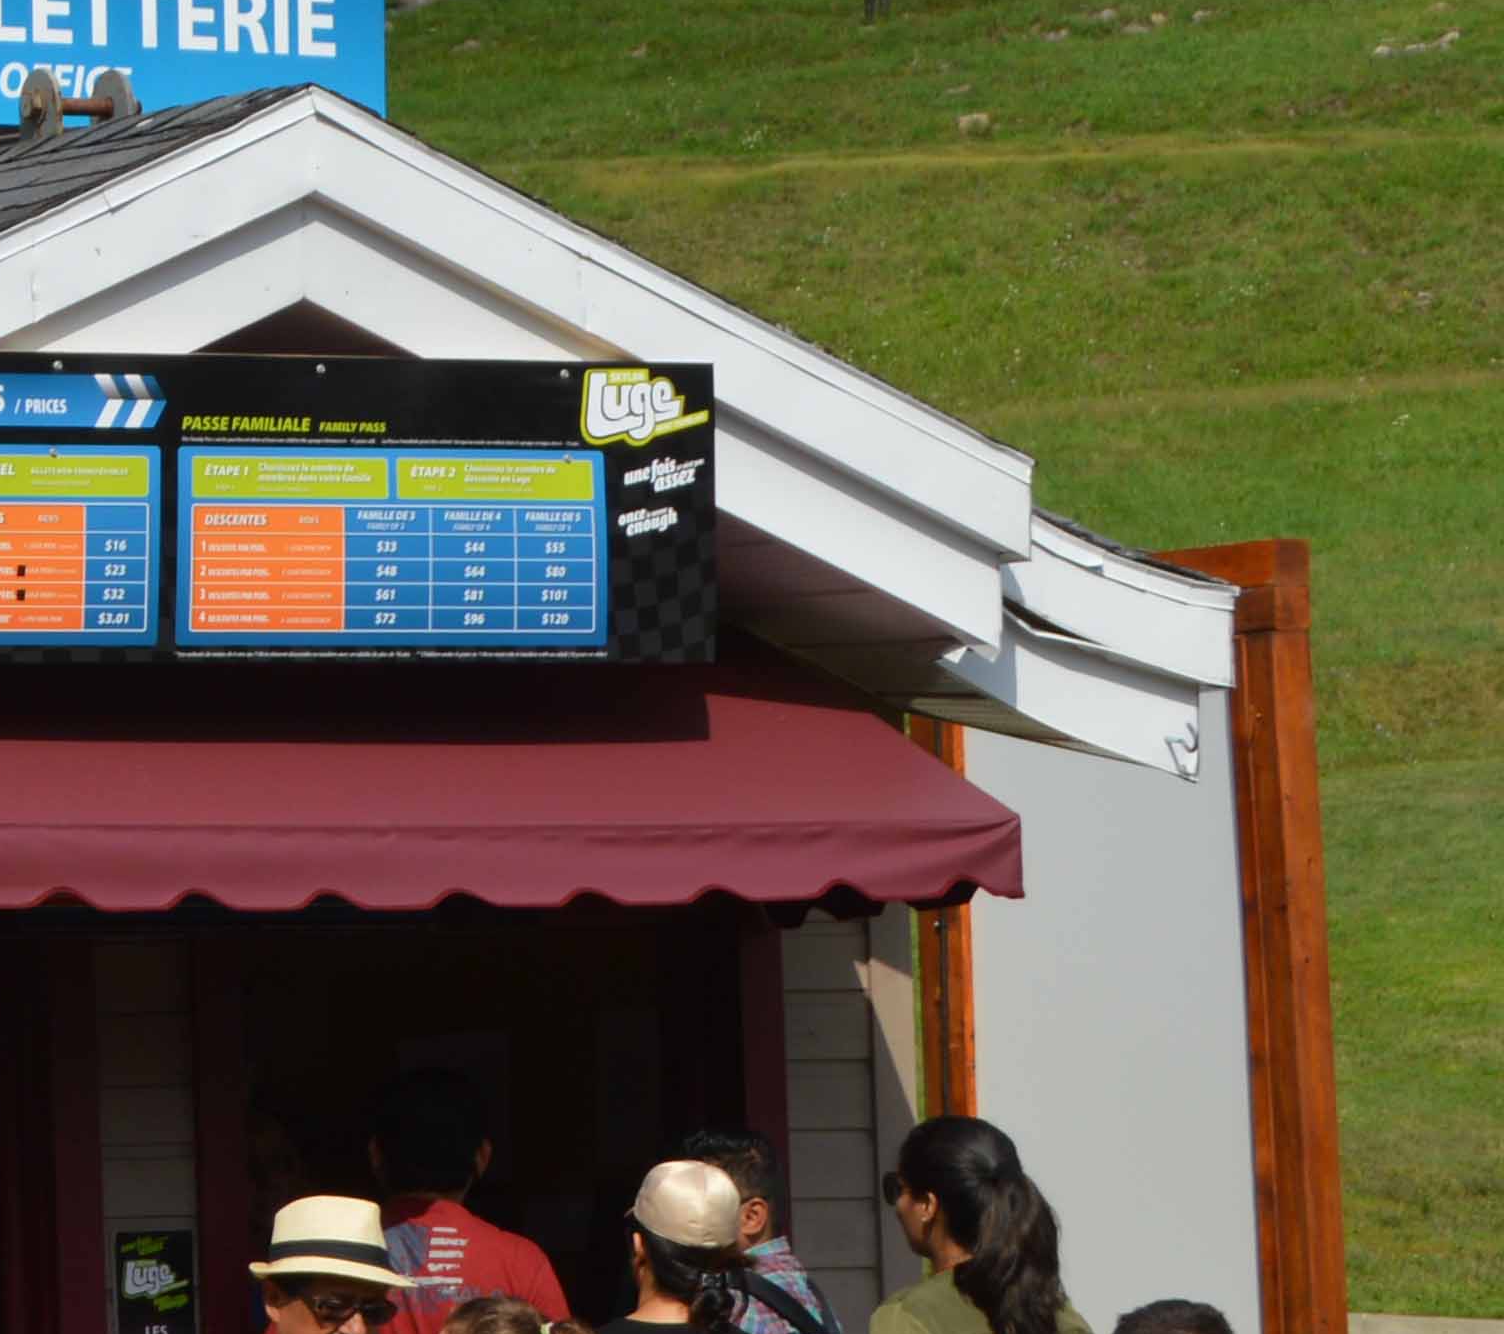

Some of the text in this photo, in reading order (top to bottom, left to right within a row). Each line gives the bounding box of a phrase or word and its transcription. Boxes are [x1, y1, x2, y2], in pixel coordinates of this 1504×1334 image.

[24, 398, 68, 415] PRICES
[586, 371, 681, 440] Luge
[182, 416, 386, 433] PASSE FAMILIALE FAMILY PASS
[204, 462, 240, 476] ÉTAPE
[411, 464, 447, 478] ÉTAPE
[654, 468, 696, 493] assez
[204, 515, 267, 527] DESCENTES
[104, 539, 127, 552] $16
[376, 540, 397, 554] $33
[464, 541, 486, 554] $44
[544, 541, 566, 554] $55
[104, 564, 127, 577] $23
[376, 565, 397, 578] $48
[464, 566, 486, 579] $64
[544, 566, 566, 579] $80
[103, 588, 125, 601] $32
[375, 589, 396, 602] $61
[463, 589, 485, 602] $81
[541, 589, 568, 602] $101
[98, 612, 130, 626] $3.01
[374, 612, 396, 626] $72
[463, 612, 485, 626] $96
[542, 612, 569, 626] $120
[125, 1260, 175, 1297] Luge
